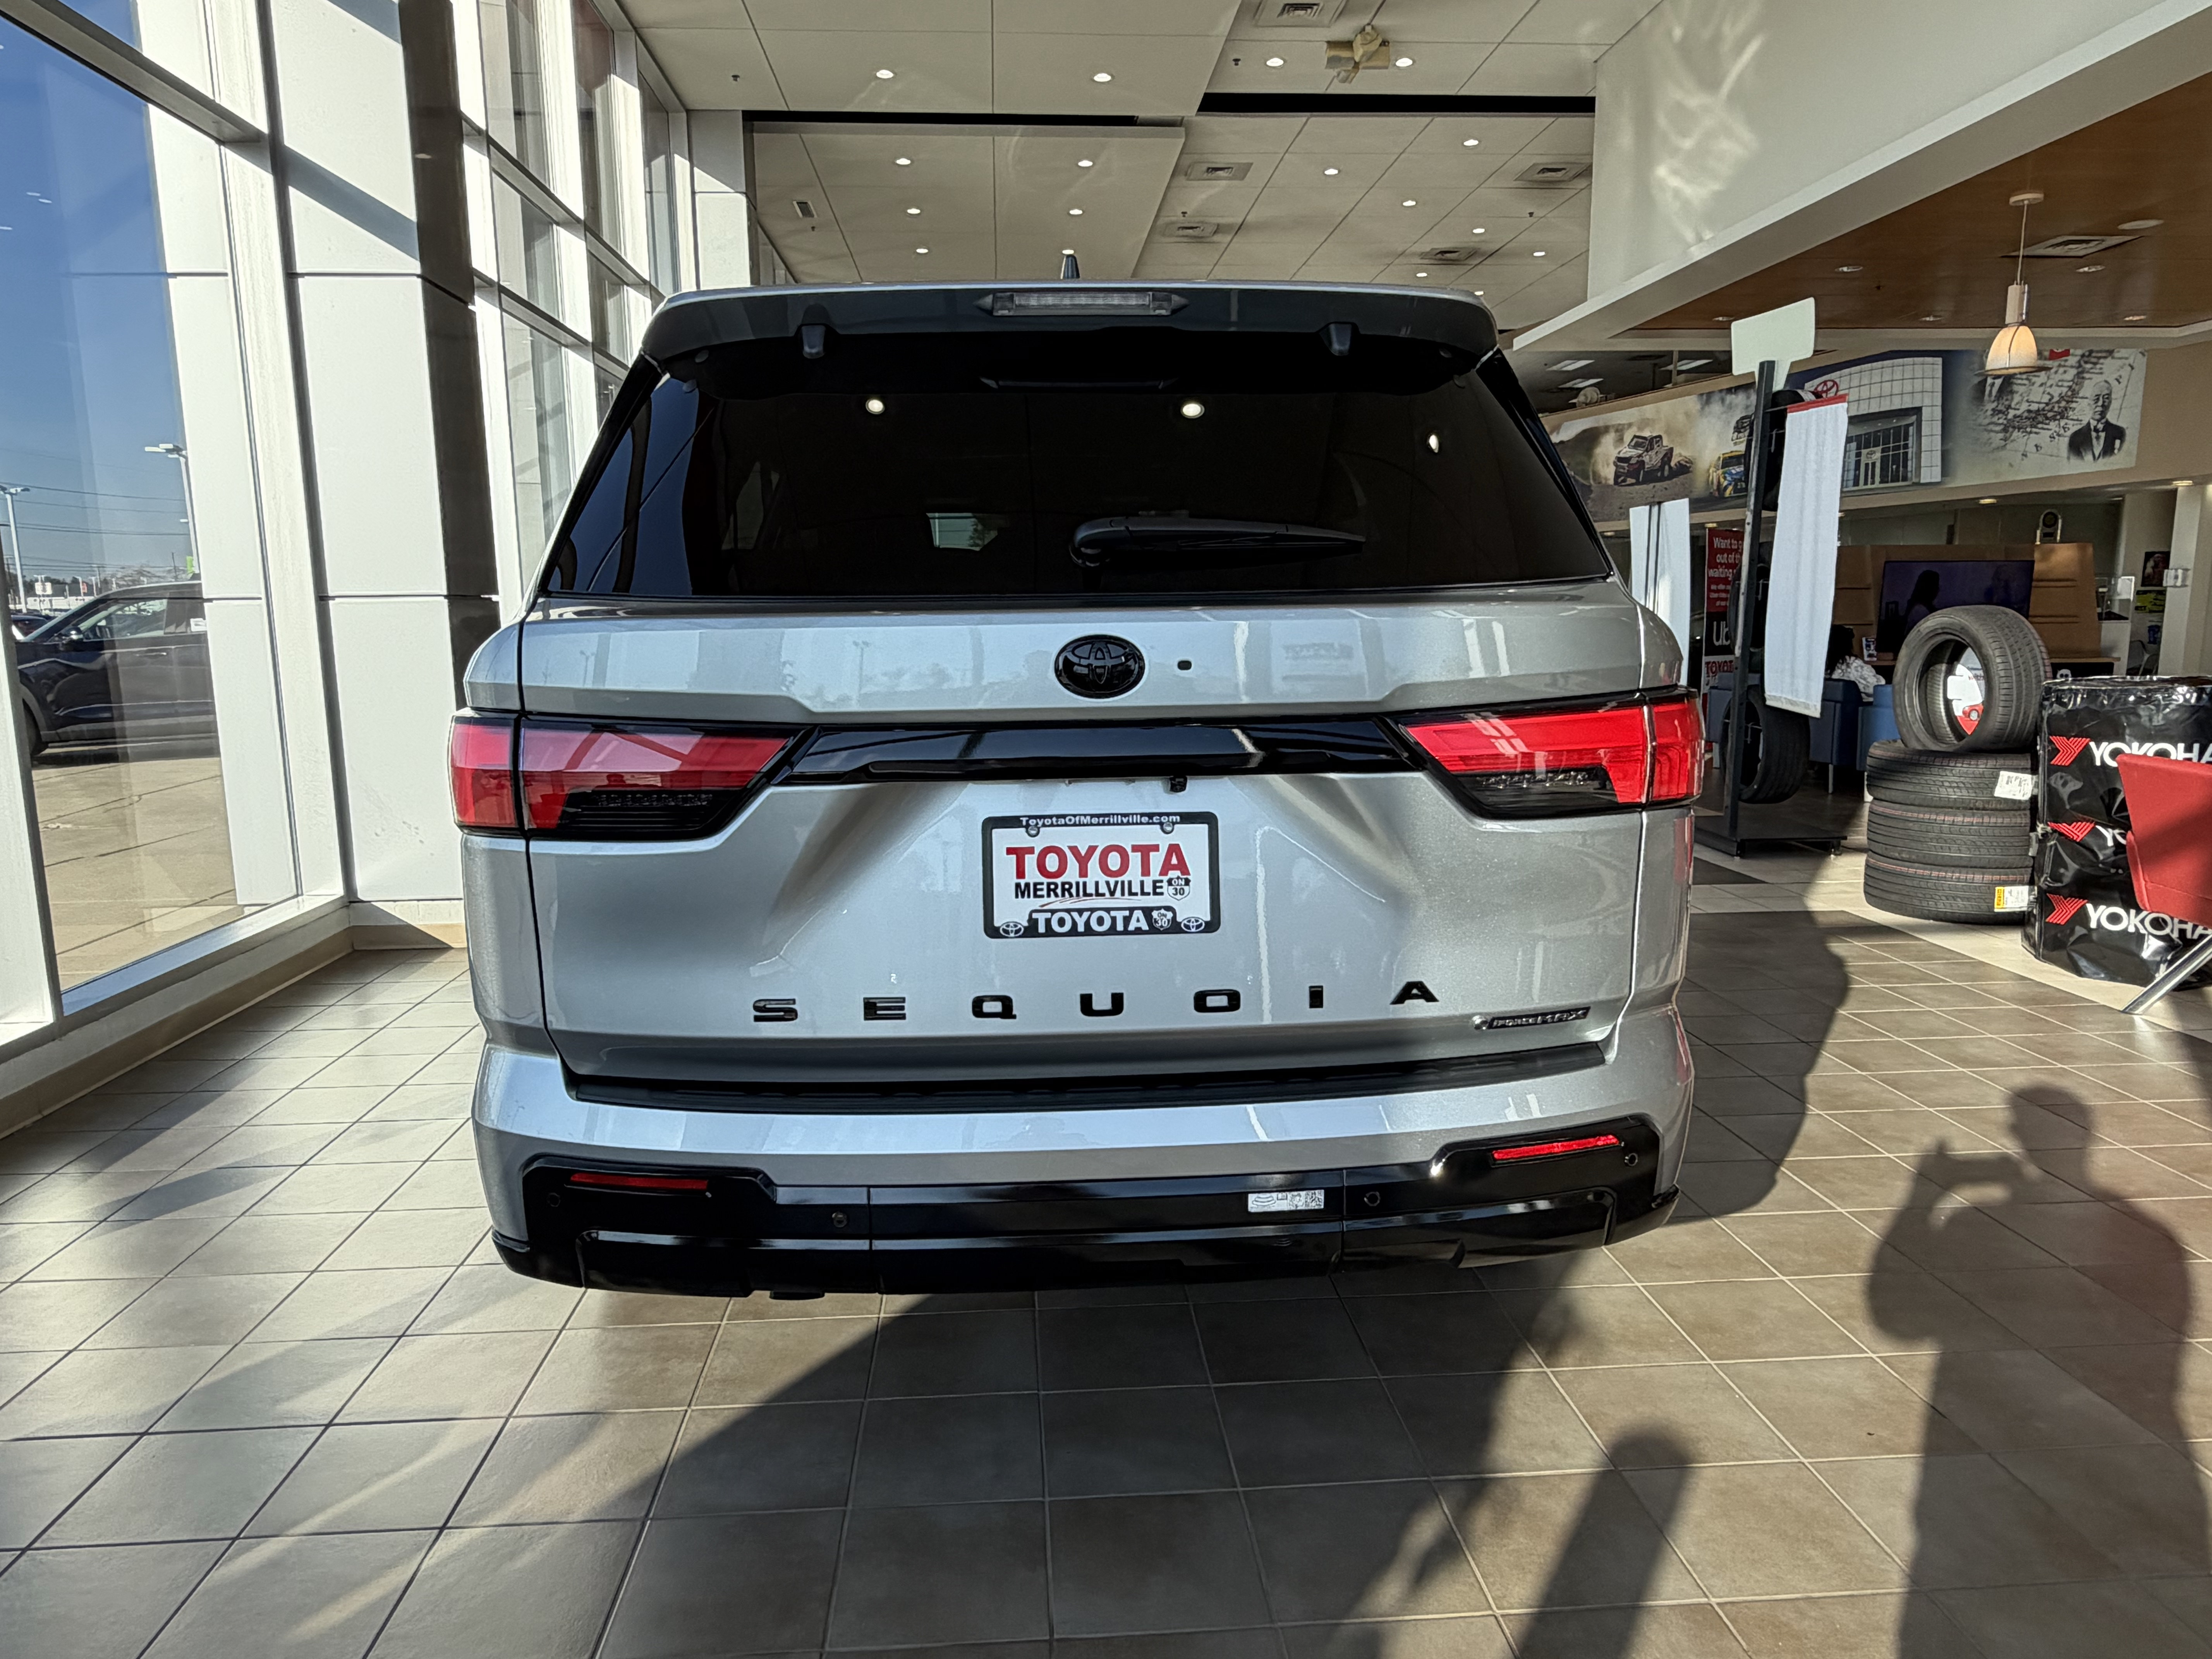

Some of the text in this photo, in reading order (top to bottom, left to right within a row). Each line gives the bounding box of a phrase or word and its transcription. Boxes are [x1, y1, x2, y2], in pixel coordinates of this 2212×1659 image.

[1713, 537, 1731, 549] Want
[1716, 553, 1728, 563] out
[1728, 552, 1735, 563] of
[1708, 565, 1732, 580] waiting
[1705, 660, 1734, 677] TOYOT
[1020, 814, 1180, 827] ToyotaOfMerrillville.com
[1006, 843, 1191, 879] TOYOTA
[1014, 879, 1164, 899] MERRILLVILLE
[1172, 887, 1185, 896] 30
[1032, 910, 1149, 933] TOYOTA
[1156, 917, 1168, 927] 30
[752, 980, 1440, 1023] SEQUOIA
